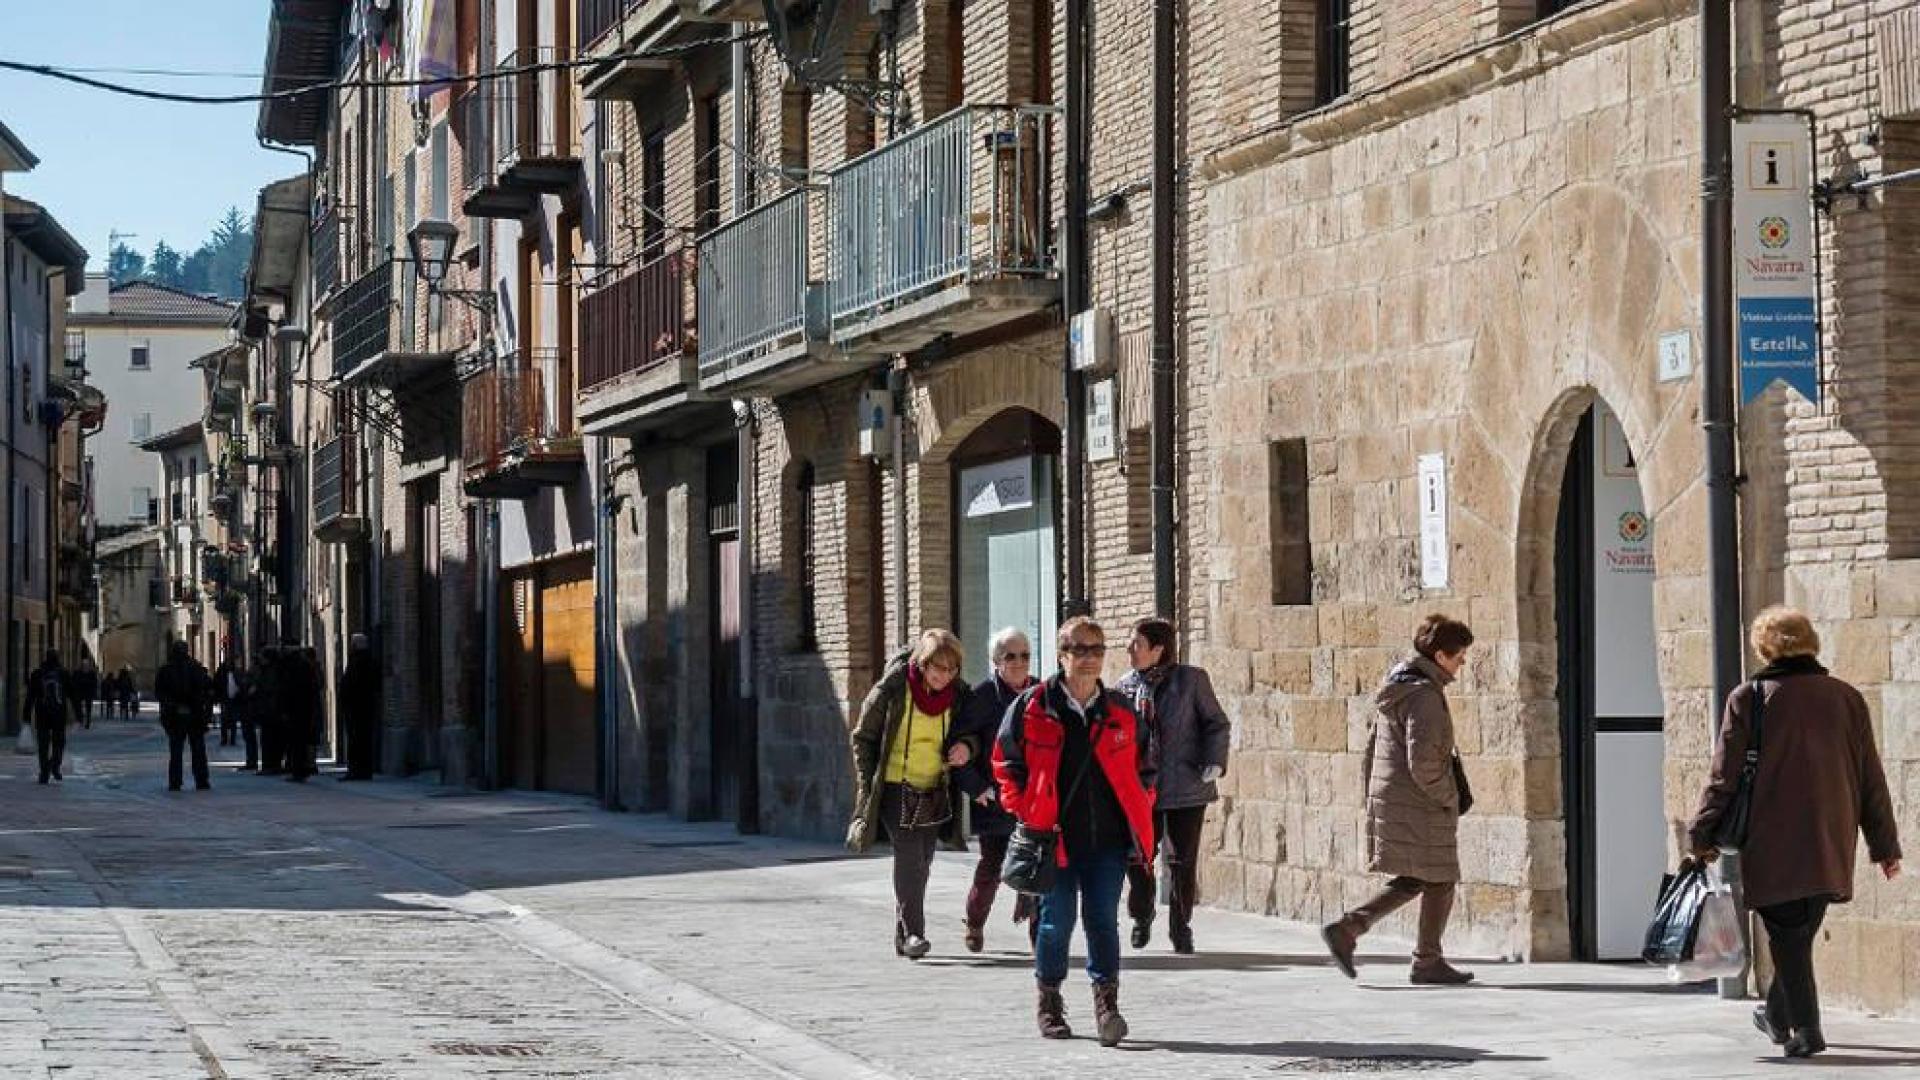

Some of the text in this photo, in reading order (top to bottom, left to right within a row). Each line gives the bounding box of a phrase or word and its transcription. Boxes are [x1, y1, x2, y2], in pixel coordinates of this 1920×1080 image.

[1765, 149, 1779, 185] i
[1746, 259, 1804, 273] Navarra
[1750, 335, 1809, 352] Estella
